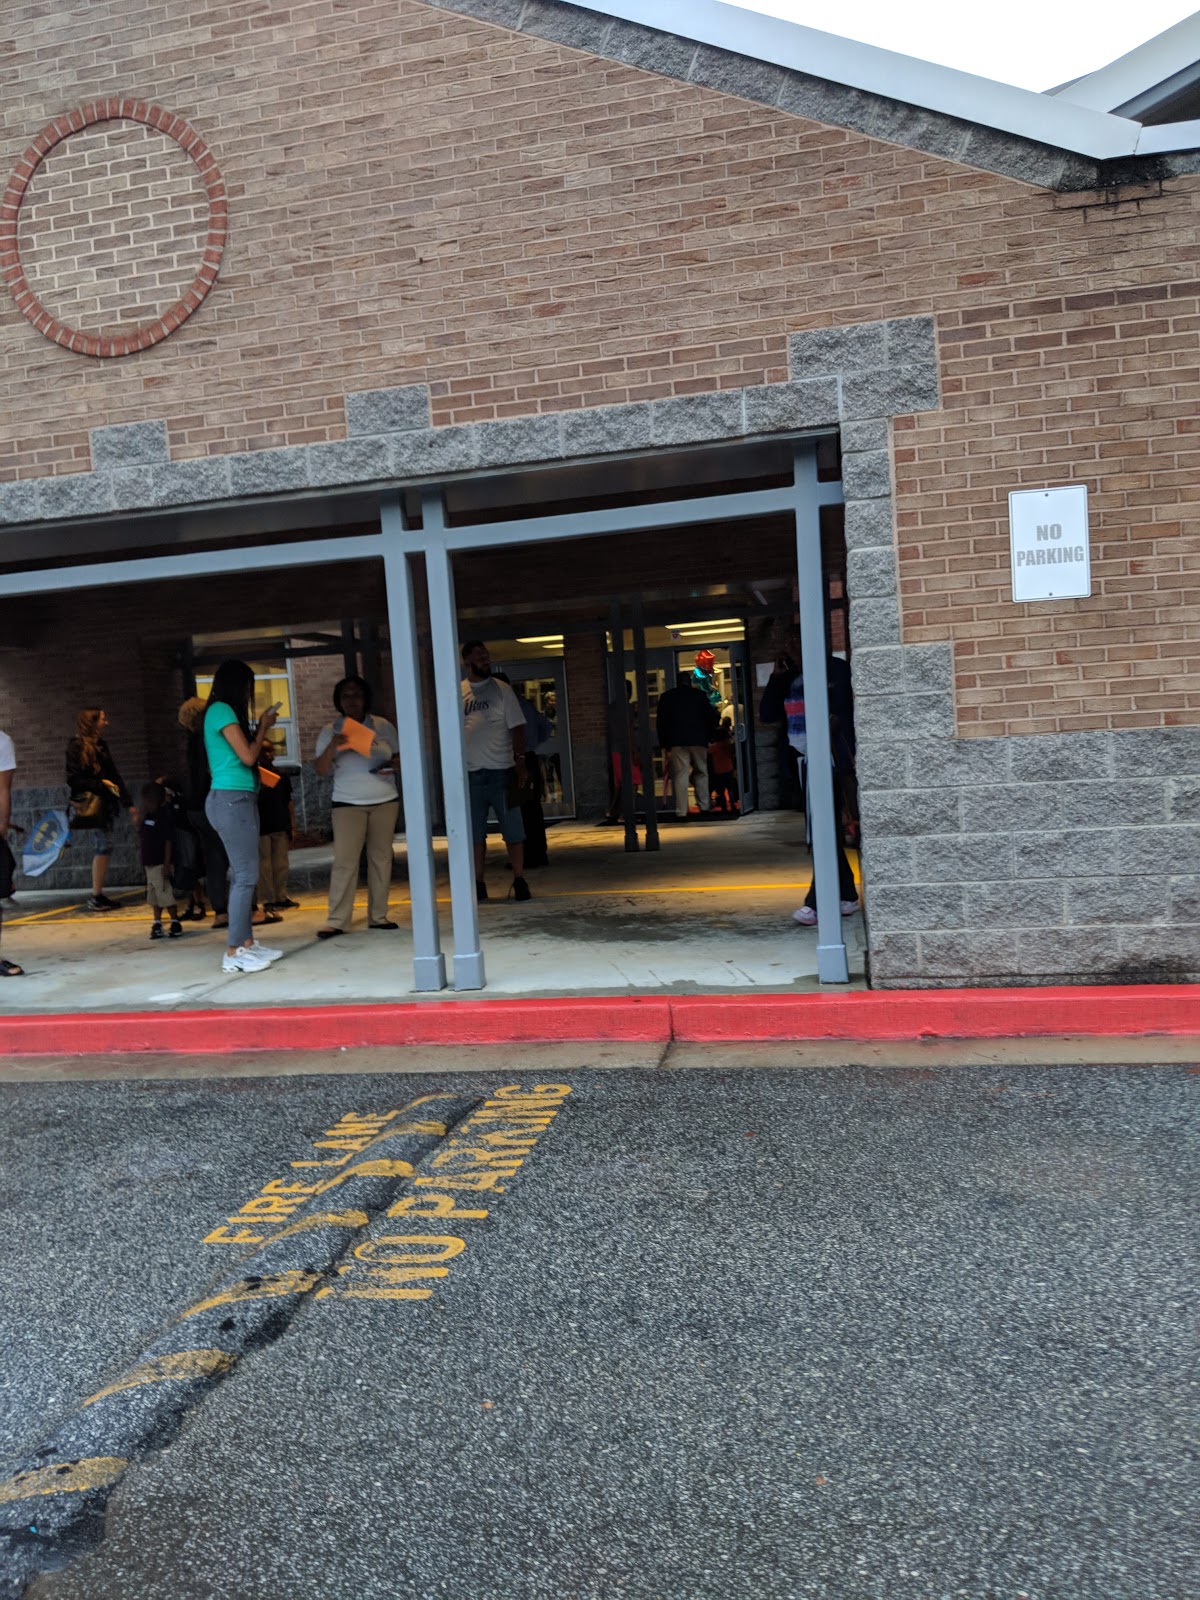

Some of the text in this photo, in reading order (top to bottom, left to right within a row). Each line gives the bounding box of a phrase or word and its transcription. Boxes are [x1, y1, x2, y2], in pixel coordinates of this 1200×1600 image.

[1016, 546, 1085, 567] PARKING
[1036, 523, 1062, 541] NO
[203, 1109, 402, 1244] FIRE LANE
[315, 1083, 573, 1299] NO PARKING
